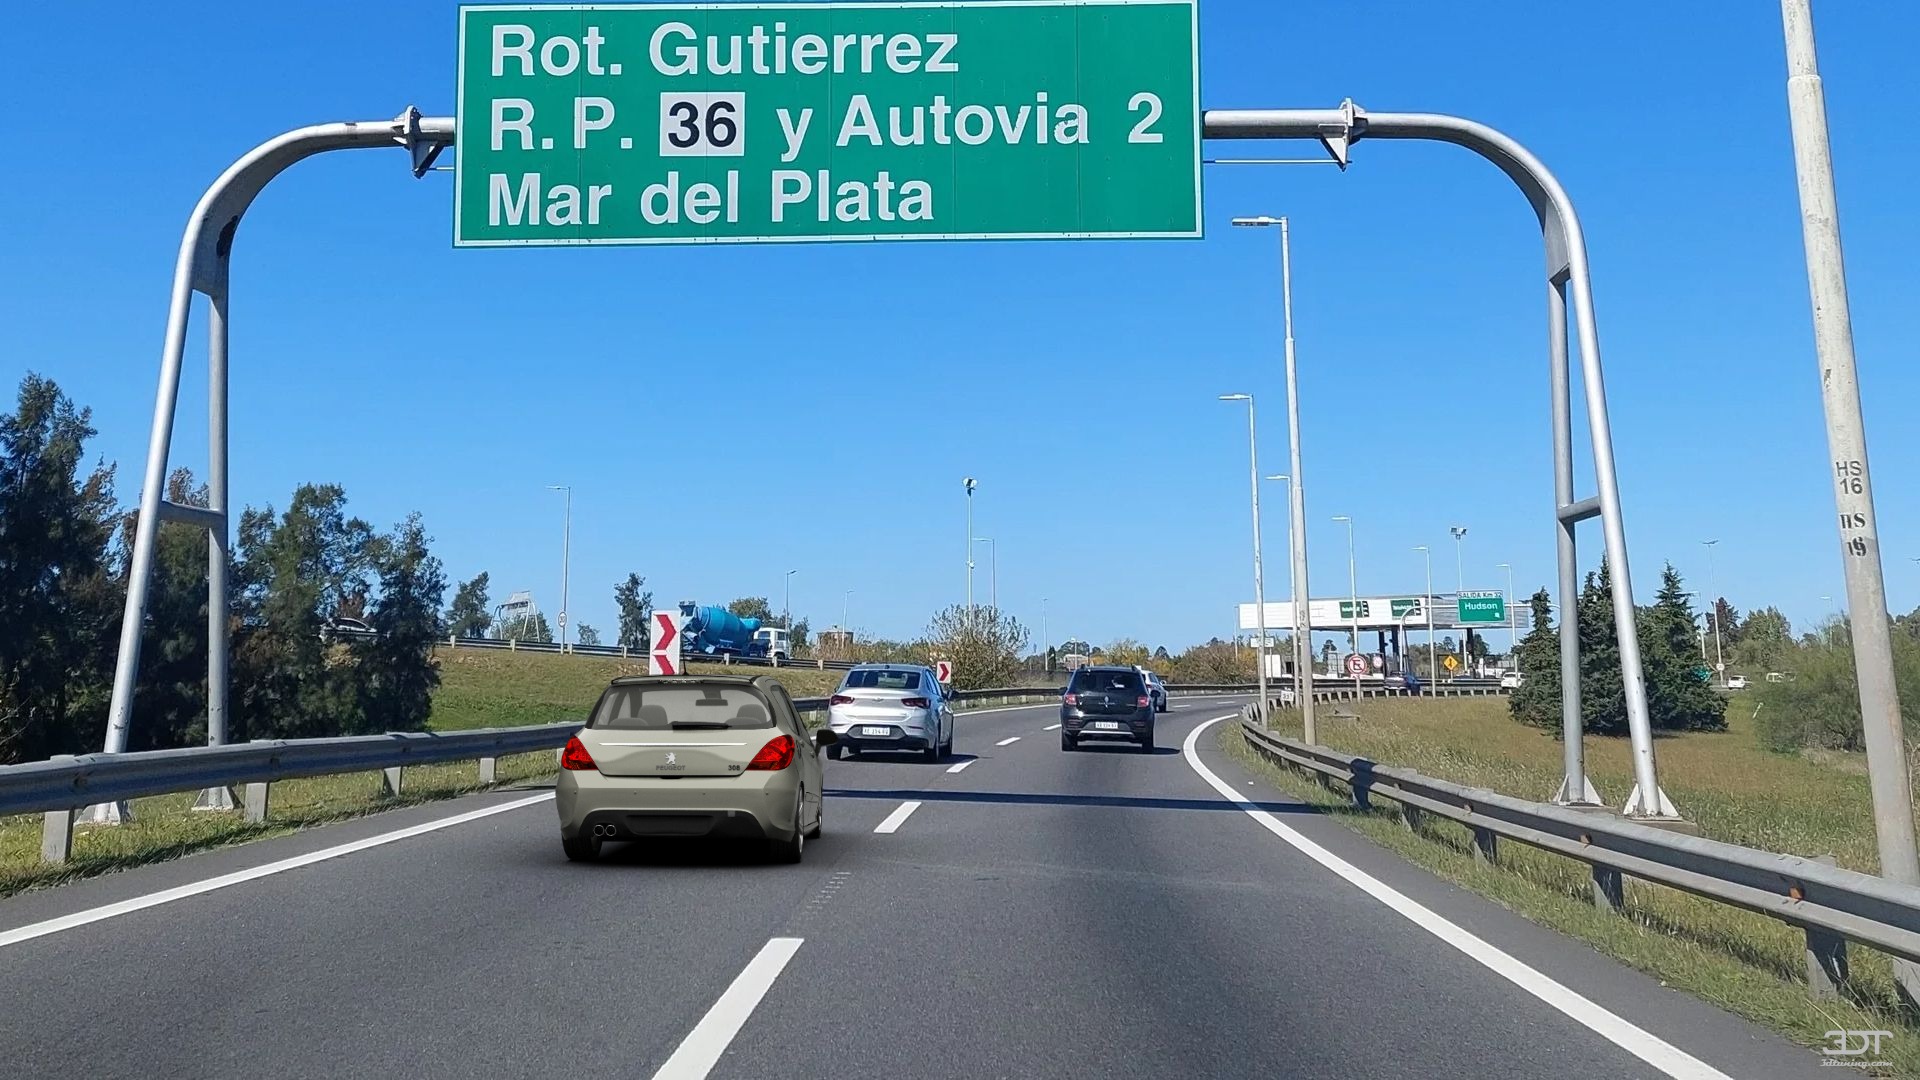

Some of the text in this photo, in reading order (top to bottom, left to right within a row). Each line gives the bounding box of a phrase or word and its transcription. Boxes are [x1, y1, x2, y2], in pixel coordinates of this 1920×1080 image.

[491, 21, 959, 76] Rot. Gutierrez
[668, 101, 737, 148] 36
[776, 107, 813, 162] y
[835, 91, 1090, 147] Autovia
[1128, 92, 1164, 144] 2
[489, 169, 934, 226] Mar del Plata
[1836, 460, 1863, 477] HS
[1840, 478, 1863, 495] 16
[1464, 602, 1498, 610] Hudson
